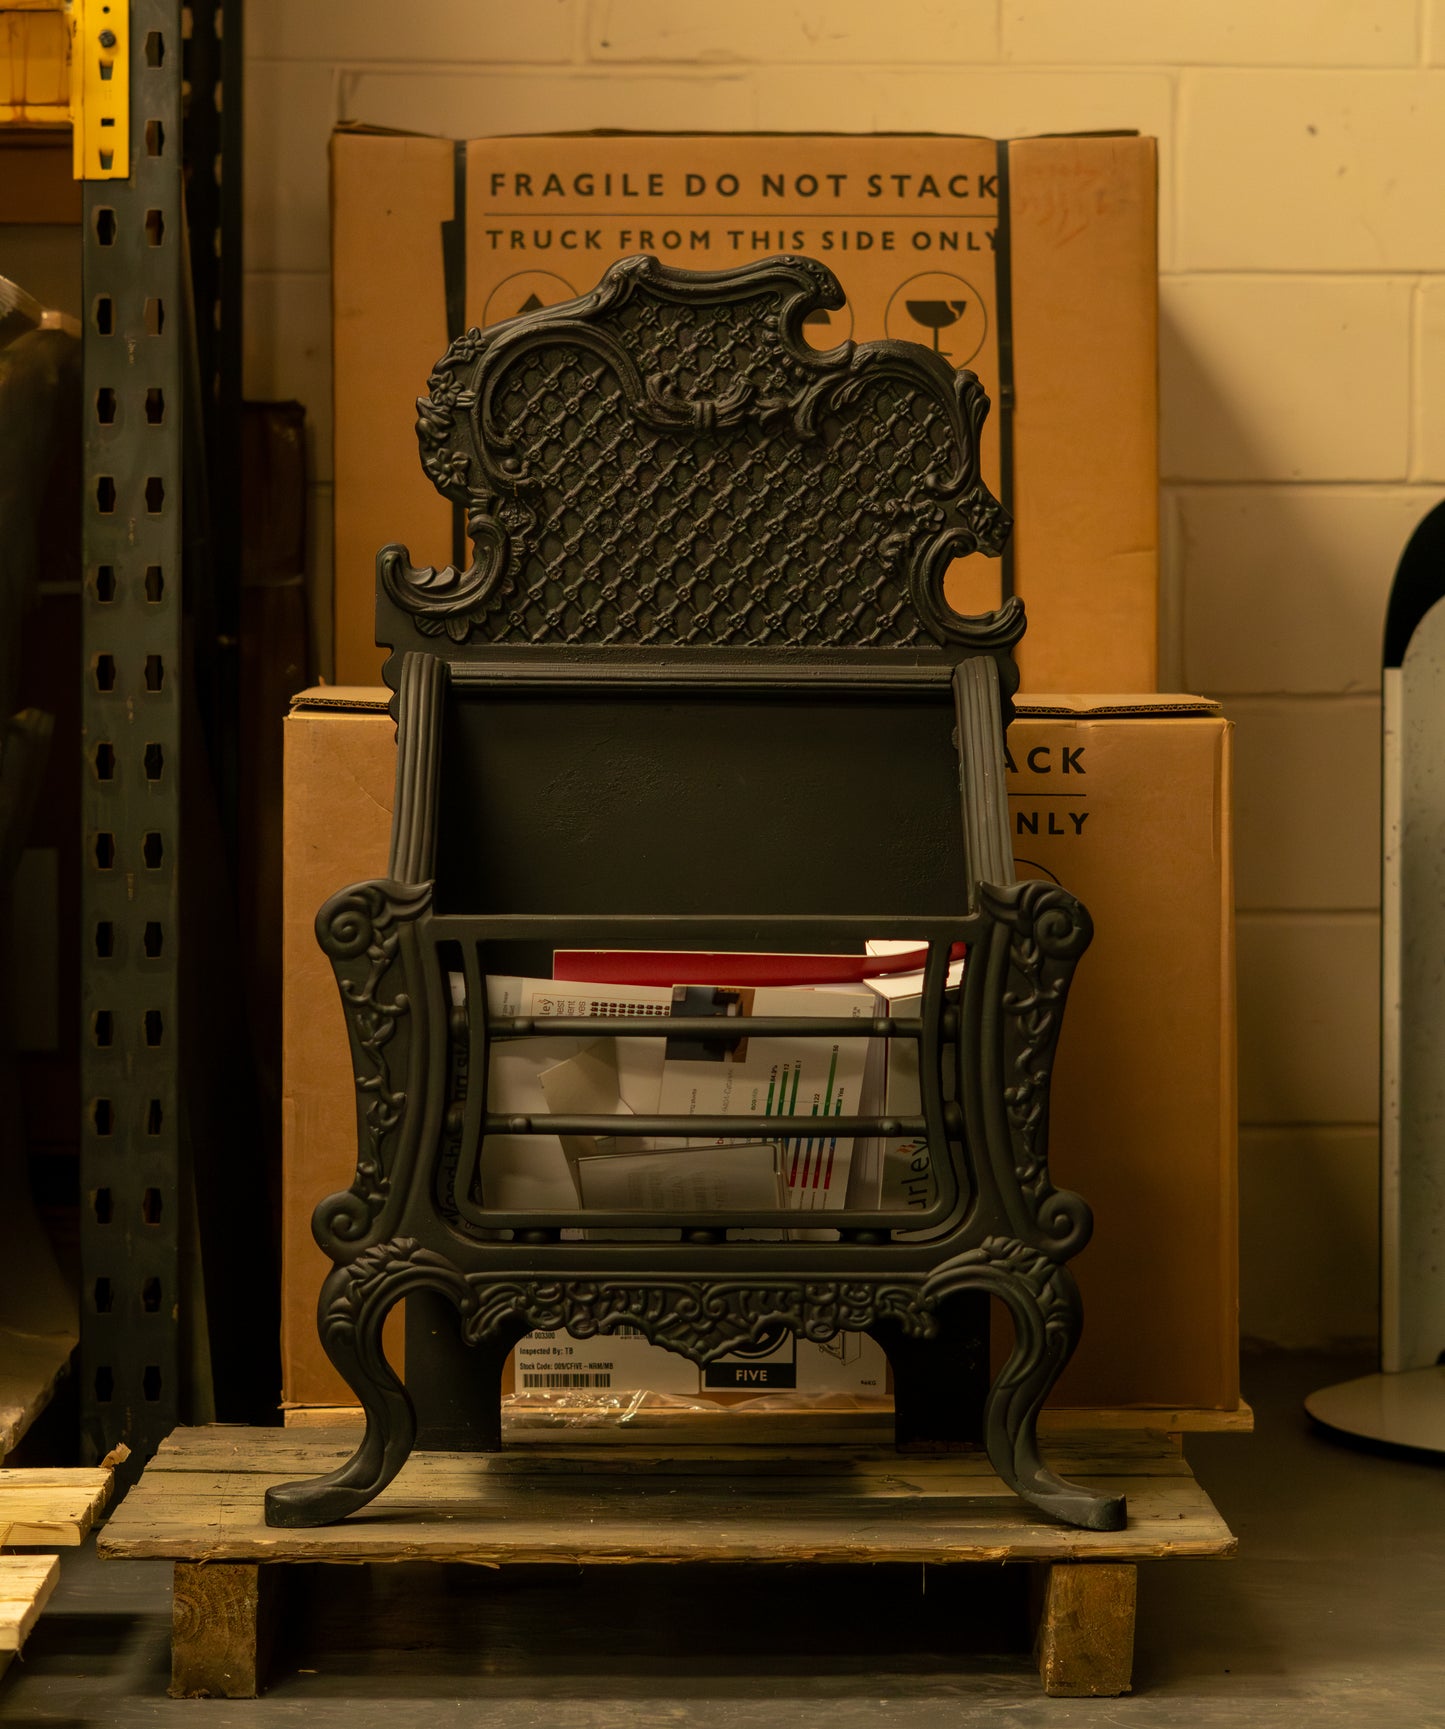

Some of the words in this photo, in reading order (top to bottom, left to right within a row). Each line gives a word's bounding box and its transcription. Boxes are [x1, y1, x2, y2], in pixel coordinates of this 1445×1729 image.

[490, 173, 665, 197] FRAGILE
[685, 174, 740, 197] DO
[761, 174, 848, 197] NOT
[867, 174, 999, 199] STACK
[486, 230, 603, 250] TRUCK
[620, 230, 711, 250] FROM
[727, 231, 805, 250] THIS
[822, 231, 896, 250] SIDE
[911, 231, 999, 251] ONLY
[1003, 746, 1086, 774] ACK
[1016, 812, 1090, 835] NLY
[520, 1347, 551, 1356] Inspected
[552, 1347, 563, 1356] By:
[520, 1362, 535, 1370] Stock
[537, 1362, 552, 1370] Code:
[736, 1369, 768, 1382] FIVE
